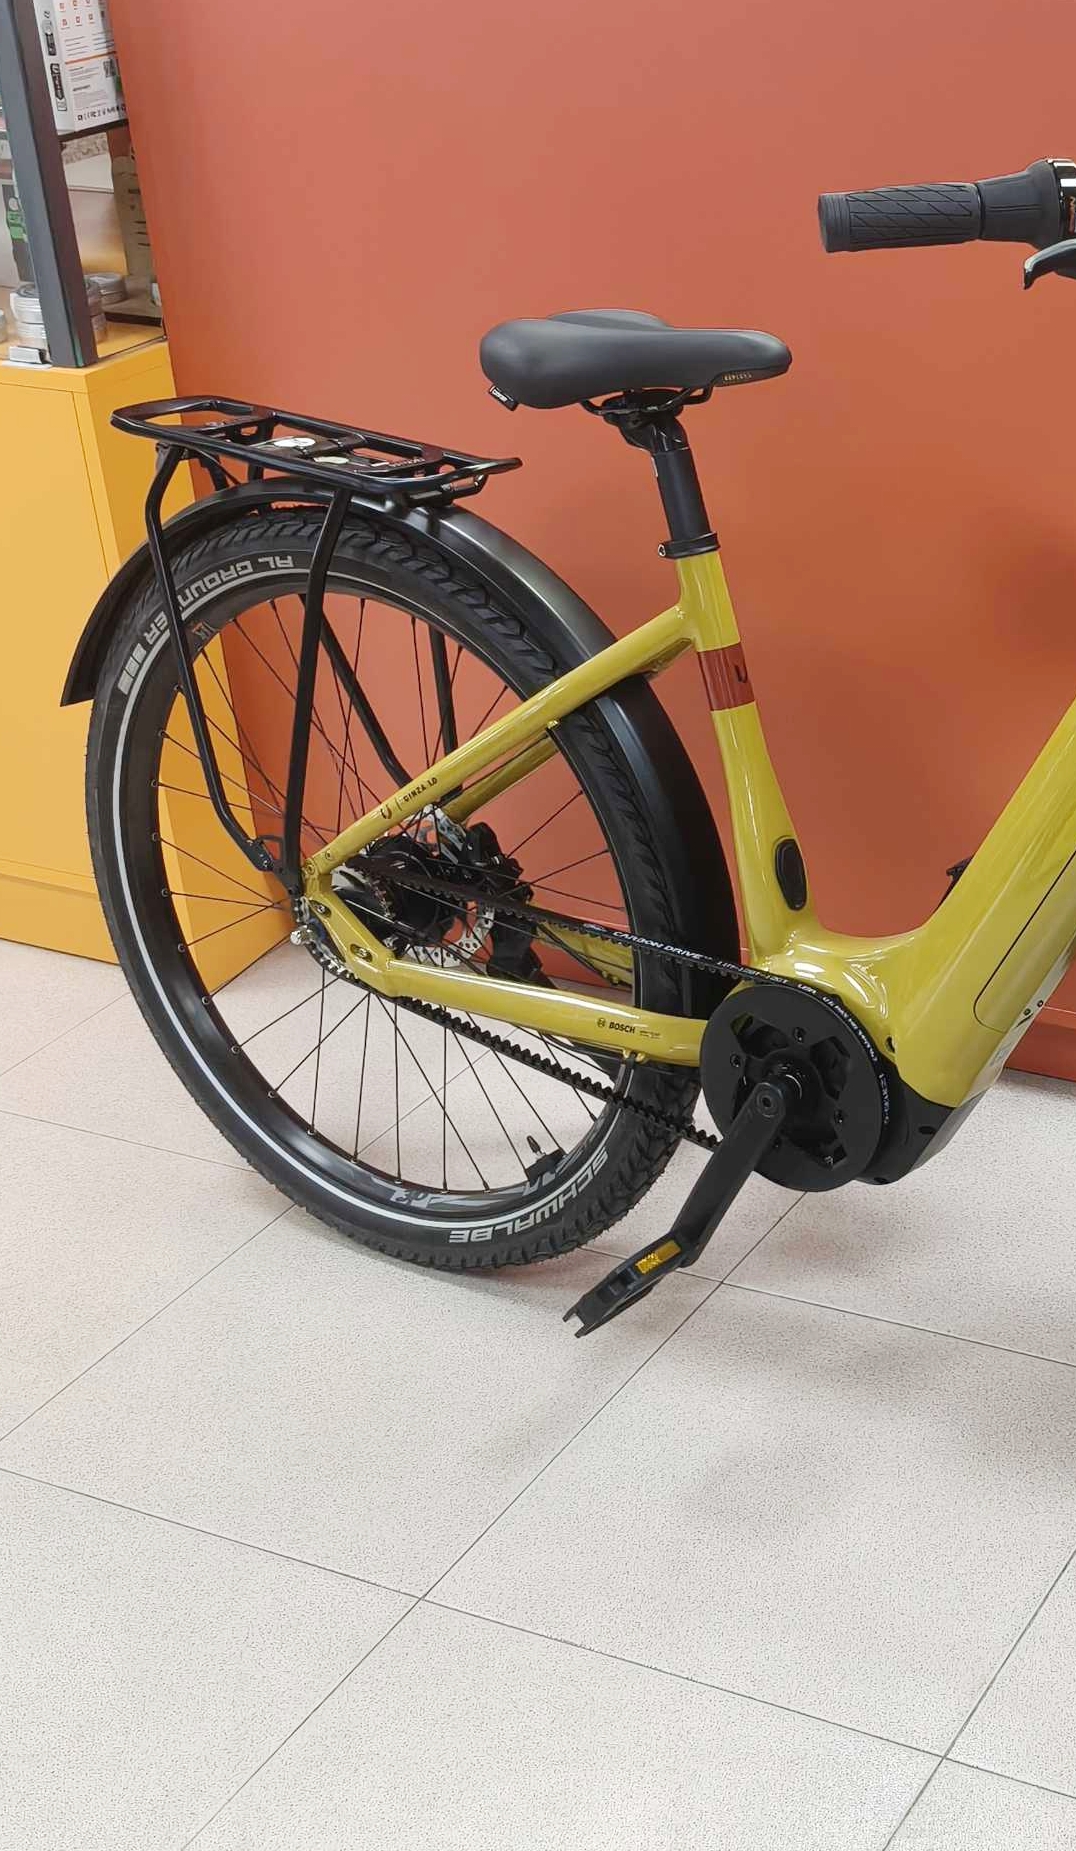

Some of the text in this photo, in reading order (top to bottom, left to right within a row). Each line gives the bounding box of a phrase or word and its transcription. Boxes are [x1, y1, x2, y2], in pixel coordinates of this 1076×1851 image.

[257, 555, 294, 569] AL
[143, 560, 254, 645] GROUNER
[612, 930, 665, 949] CARBON
[609, 1021, 636, 1034] BOSCH
[449, 1147, 610, 1244] SCHWALBE
